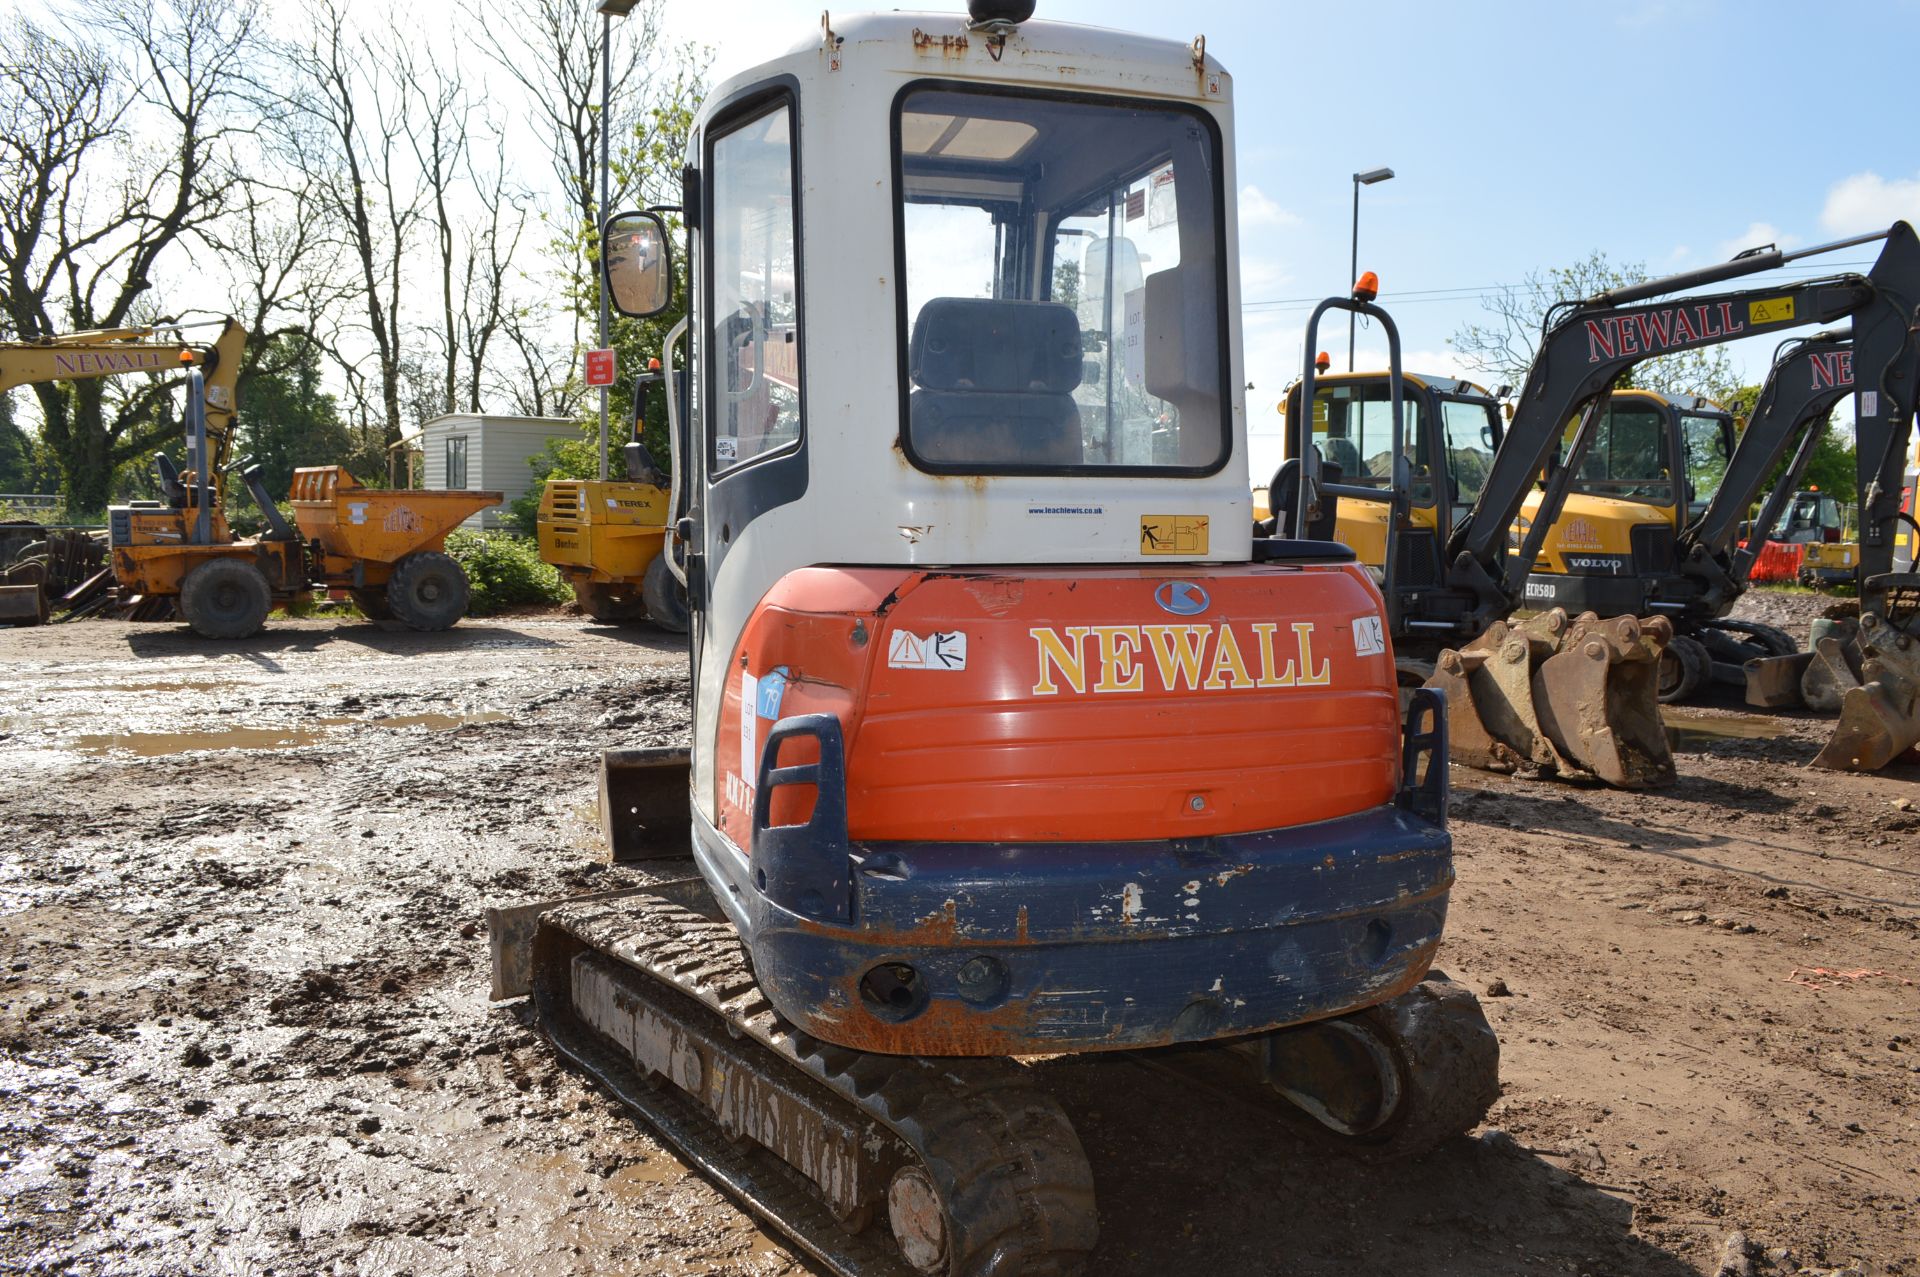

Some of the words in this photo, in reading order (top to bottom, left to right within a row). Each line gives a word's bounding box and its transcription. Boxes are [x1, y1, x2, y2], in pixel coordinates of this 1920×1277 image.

[1129, 311, 1141, 325] LOT
[1584, 302, 1743, 362] NEWALL
[1127, 335, 1138, 348] 131
[55, 351, 168, 376] NEWALL
[619, 500, 652, 508] TEREX
[1028, 506, 1103, 515] www.leachlewis.co.uk
[1569, 558, 1622, 568] VOLVO
[1526, 583, 1556, 598] ECR58D
[1029, 622, 1331, 695] NEWALL
[765, 687, 779, 716] 79
